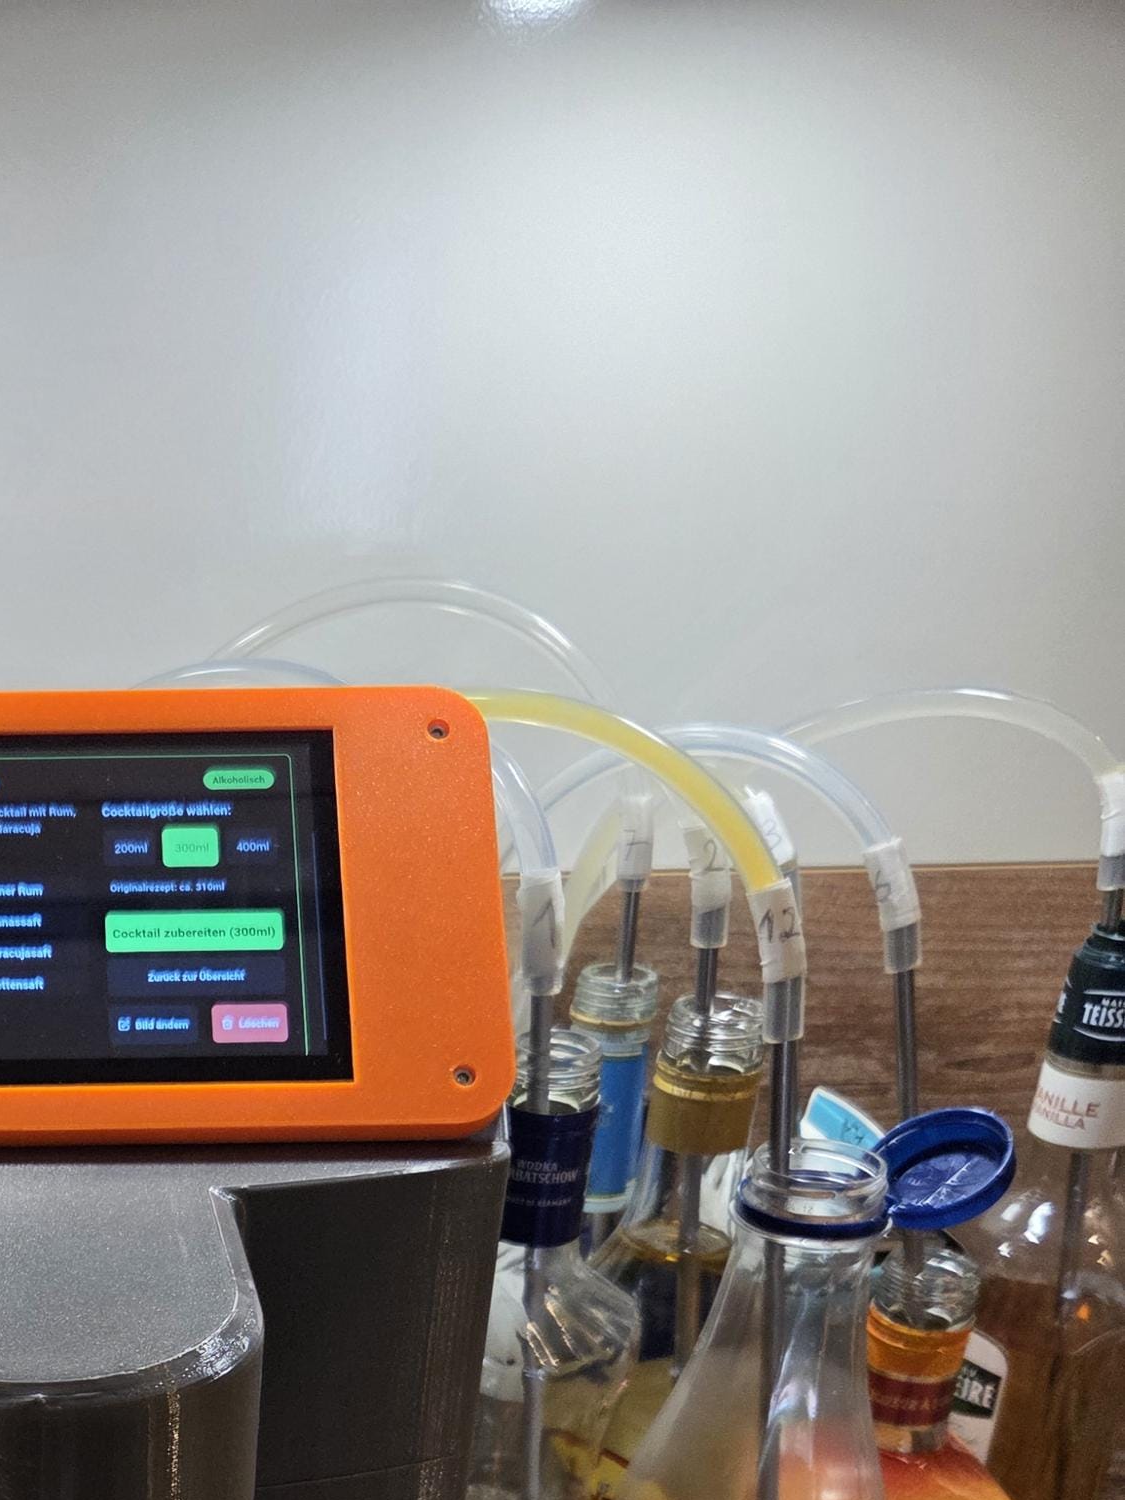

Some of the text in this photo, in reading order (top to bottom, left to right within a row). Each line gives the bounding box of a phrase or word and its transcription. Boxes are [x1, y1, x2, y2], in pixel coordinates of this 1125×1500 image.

[211, 773, 266, 785] Alkoholisch
[29, 804, 46, 818] mit
[49, 803, 76, 818] Rum,
[187, 801, 232, 817] wählen:
[114, 840, 148, 854] 200ml
[174, 841, 210, 852] 300ml
[236, 838, 270, 852] 400ml
[18, 882, 44, 897] Rum
[110, 880, 177, 894] Originalrezept:
[195, 881, 226, 892] 310ml
[112, 926, 276, 940] Cocktail zubereiten (300ml)
[147, 967, 246, 982] Zurück zur Übersicht
[135, 1017, 154, 1030] Bild
